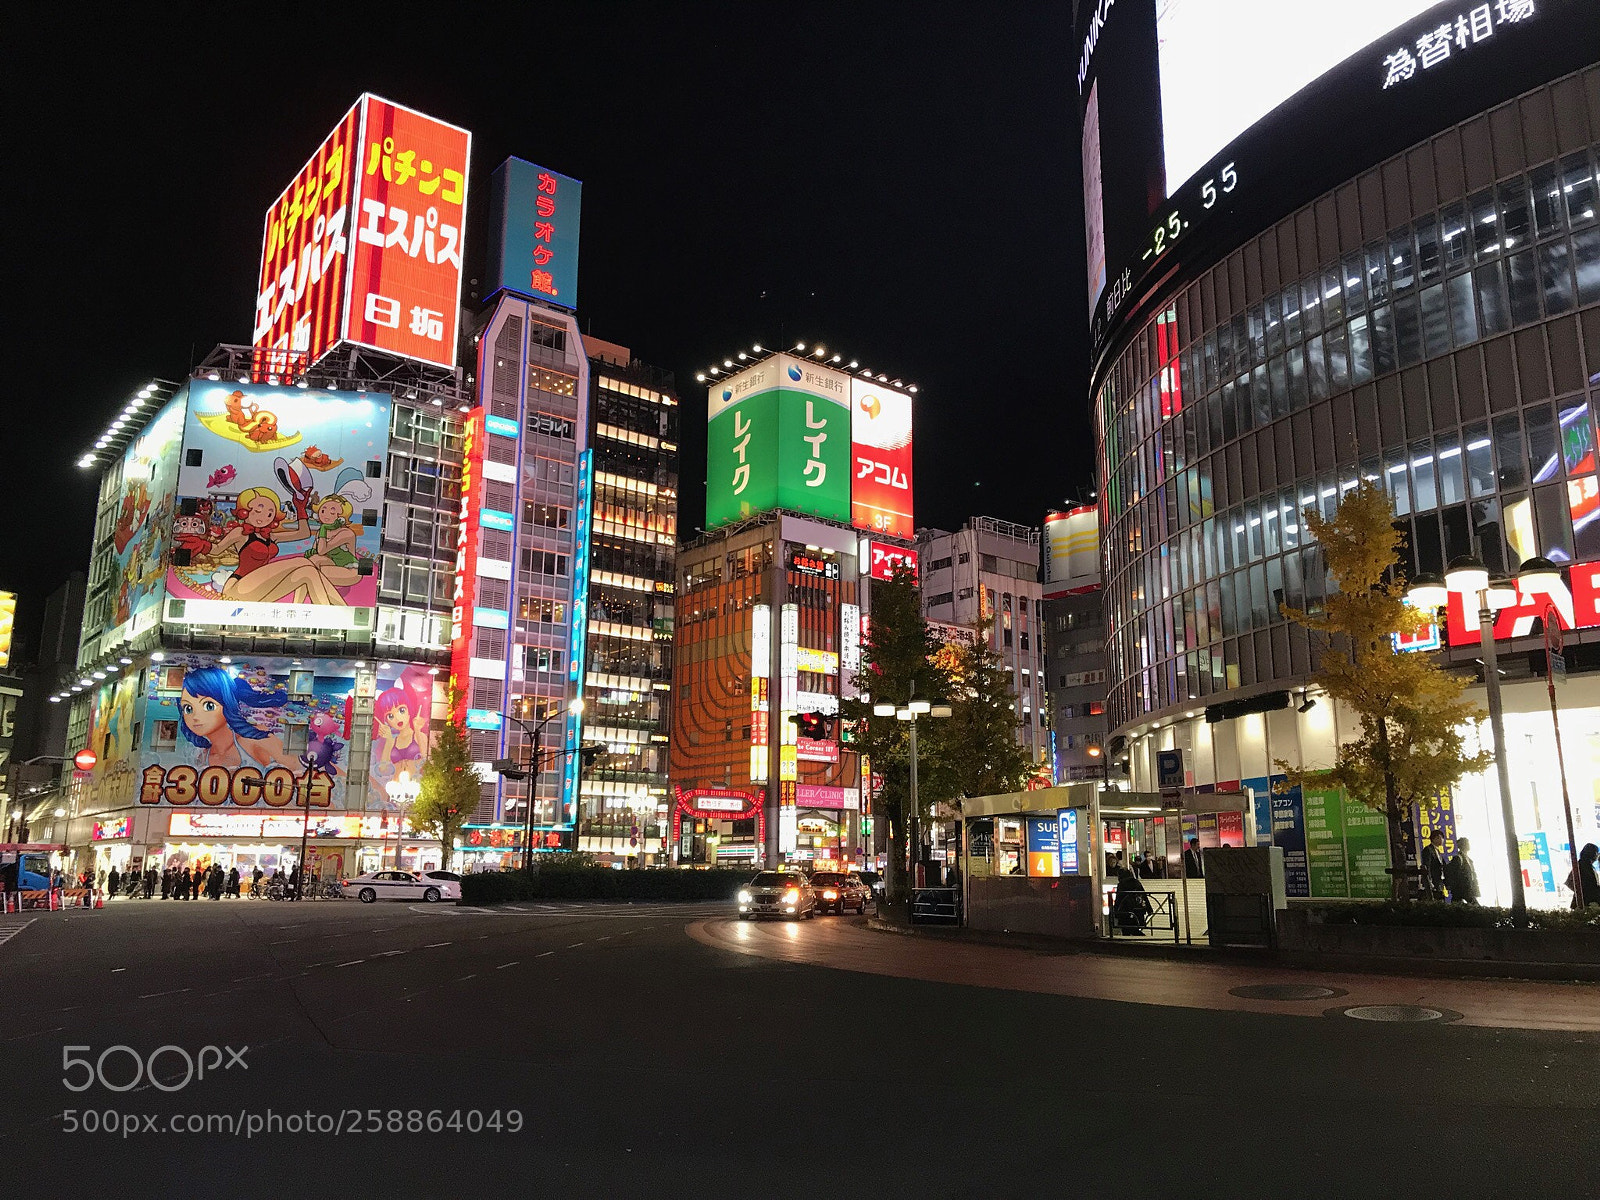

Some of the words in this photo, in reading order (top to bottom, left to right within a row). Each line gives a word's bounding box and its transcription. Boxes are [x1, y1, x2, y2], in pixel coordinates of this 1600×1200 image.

[1382, 0, 1535, 90] 為替相場
[267, 144, 344, 264] パチンコ
[367, 137, 463, 205] パチンコ
[359, 198, 460, 270] エスパス
[531, 173, 557, 295] カラオケ館
[252, 205, 347, 340] エスパス
[735, 371, 765, 394] 新生銀行
[805, 371, 844, 393] 新生銀行
[461, 417, 475, 492] パチンコ
[732, 411, 751, 495] レイク
[803, 400, 827, 487] レイク
[856, 457, 908, 490] アコム
[454, 496, 469, 601] エスパス
[874, 514, 892, 529] 3F
[1061, 817, 1070, 840] P
[1273, 799, 1293, 808] エアコン
[1036, 858, 1046, 874] 4
